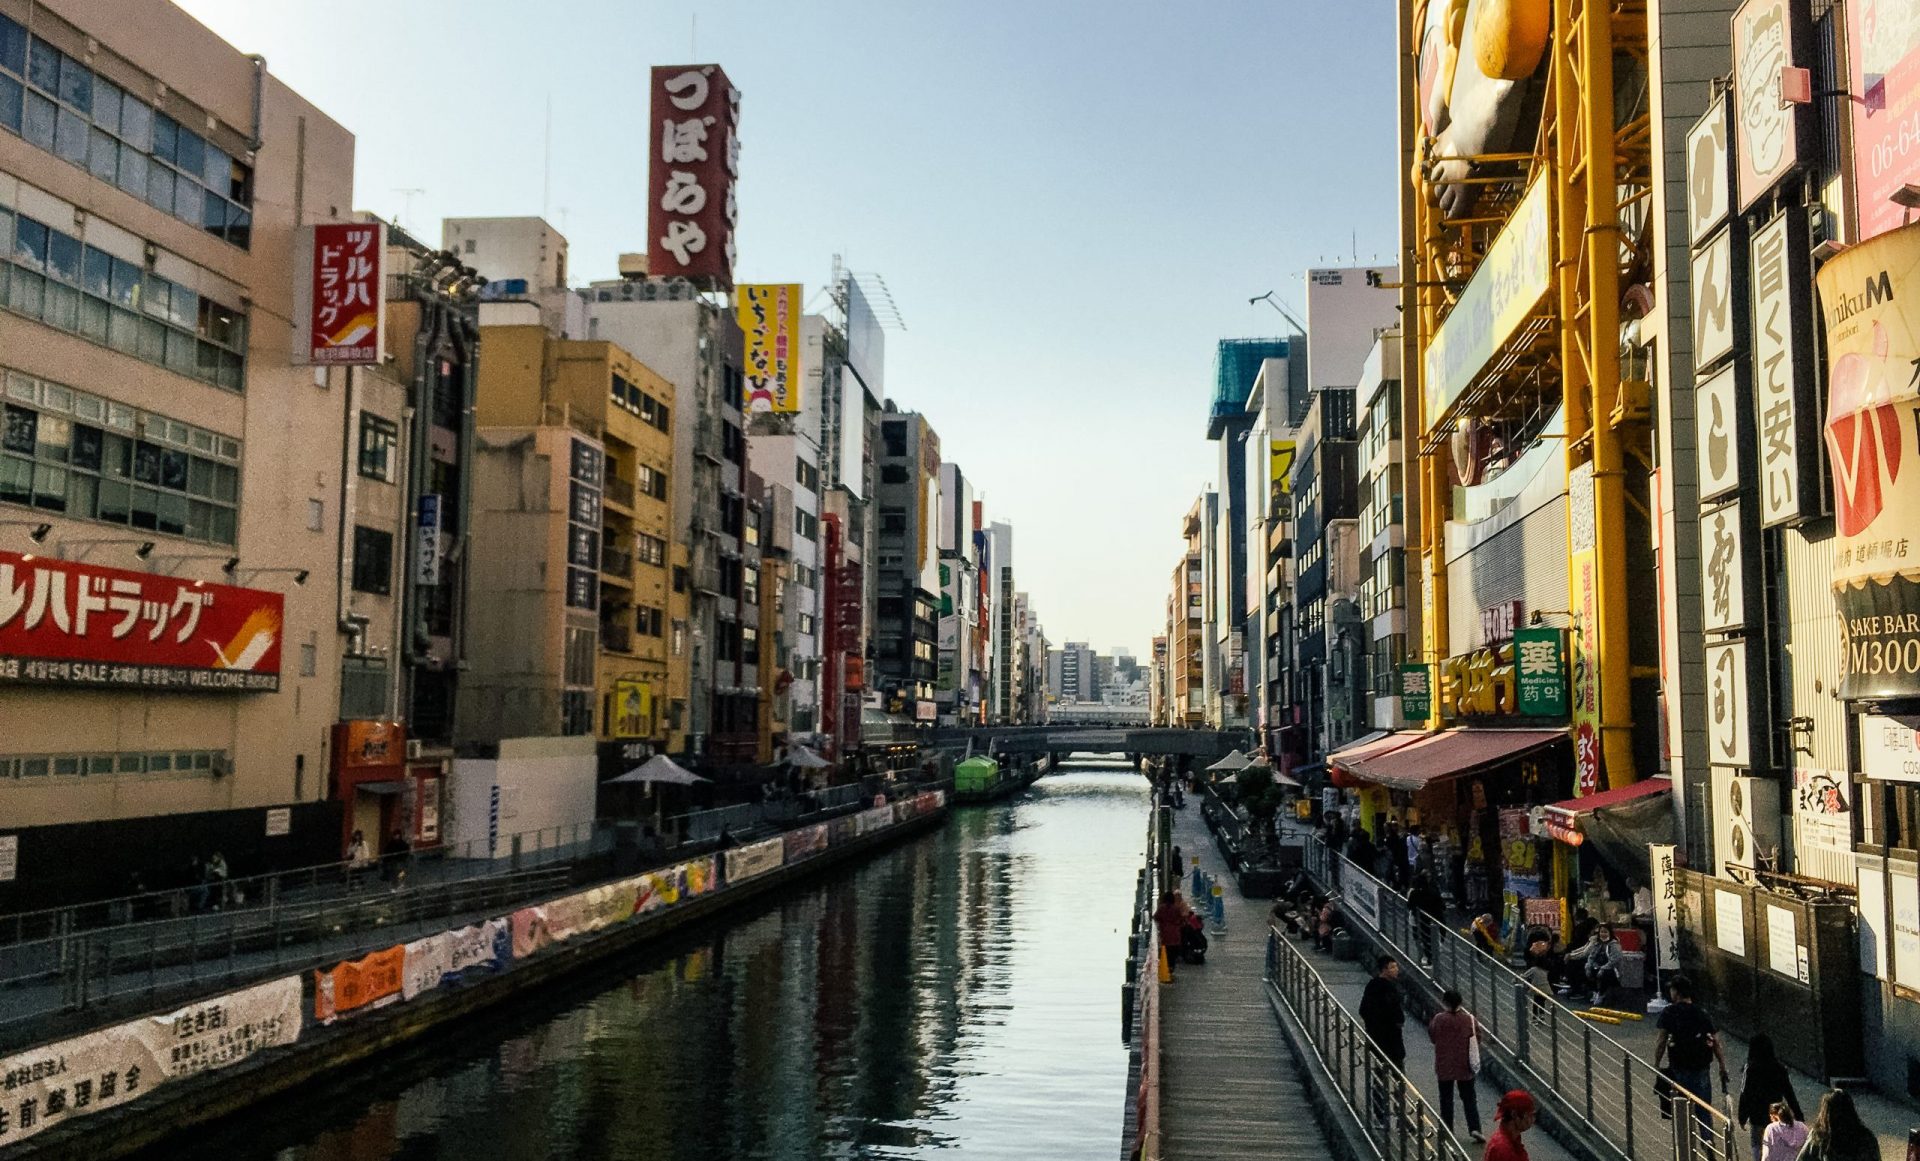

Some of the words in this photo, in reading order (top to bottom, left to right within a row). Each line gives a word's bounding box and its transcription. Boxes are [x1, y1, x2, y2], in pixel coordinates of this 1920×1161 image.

[660, 65, 715, 267] づぼらや
[318, 244, 345, 328] ドラッグ
[344, 230, 373, 306] ツルハ
[1757, 227, 1793, 514] 旨くて安い
[1850, 616, 1880, 637] SAKE
[1883, 612, 1920, 635] BAR
[72, 663, 107, 681] SALE
[189, 670, 244, 688] WELCOME
[1519, 640, 1558, 676] 薬
[1520, 677, 1560, 685] Medicine
